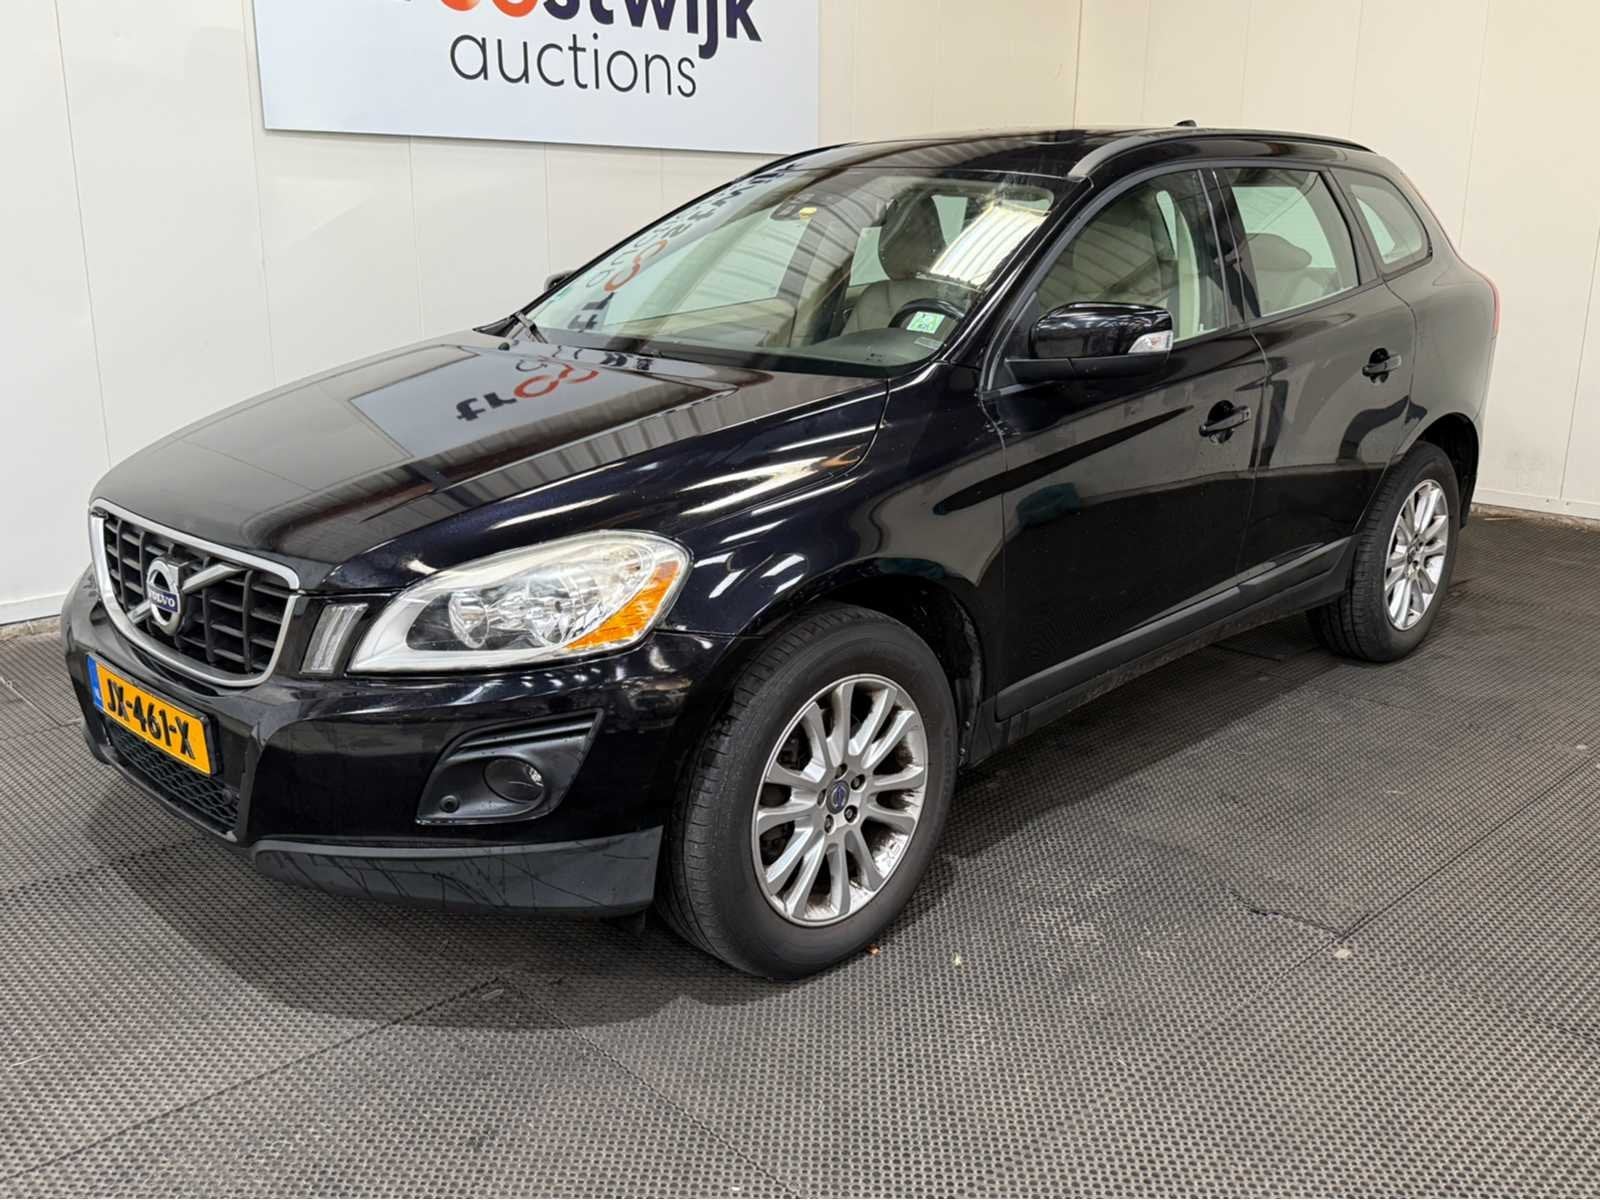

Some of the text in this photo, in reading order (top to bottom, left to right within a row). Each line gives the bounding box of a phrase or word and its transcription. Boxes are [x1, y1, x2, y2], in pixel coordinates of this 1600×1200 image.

[440, 0, 762, 59] wijk
[450, 32, 697, 97] auctions
[107, 678, 196, 760] JX-461-X
